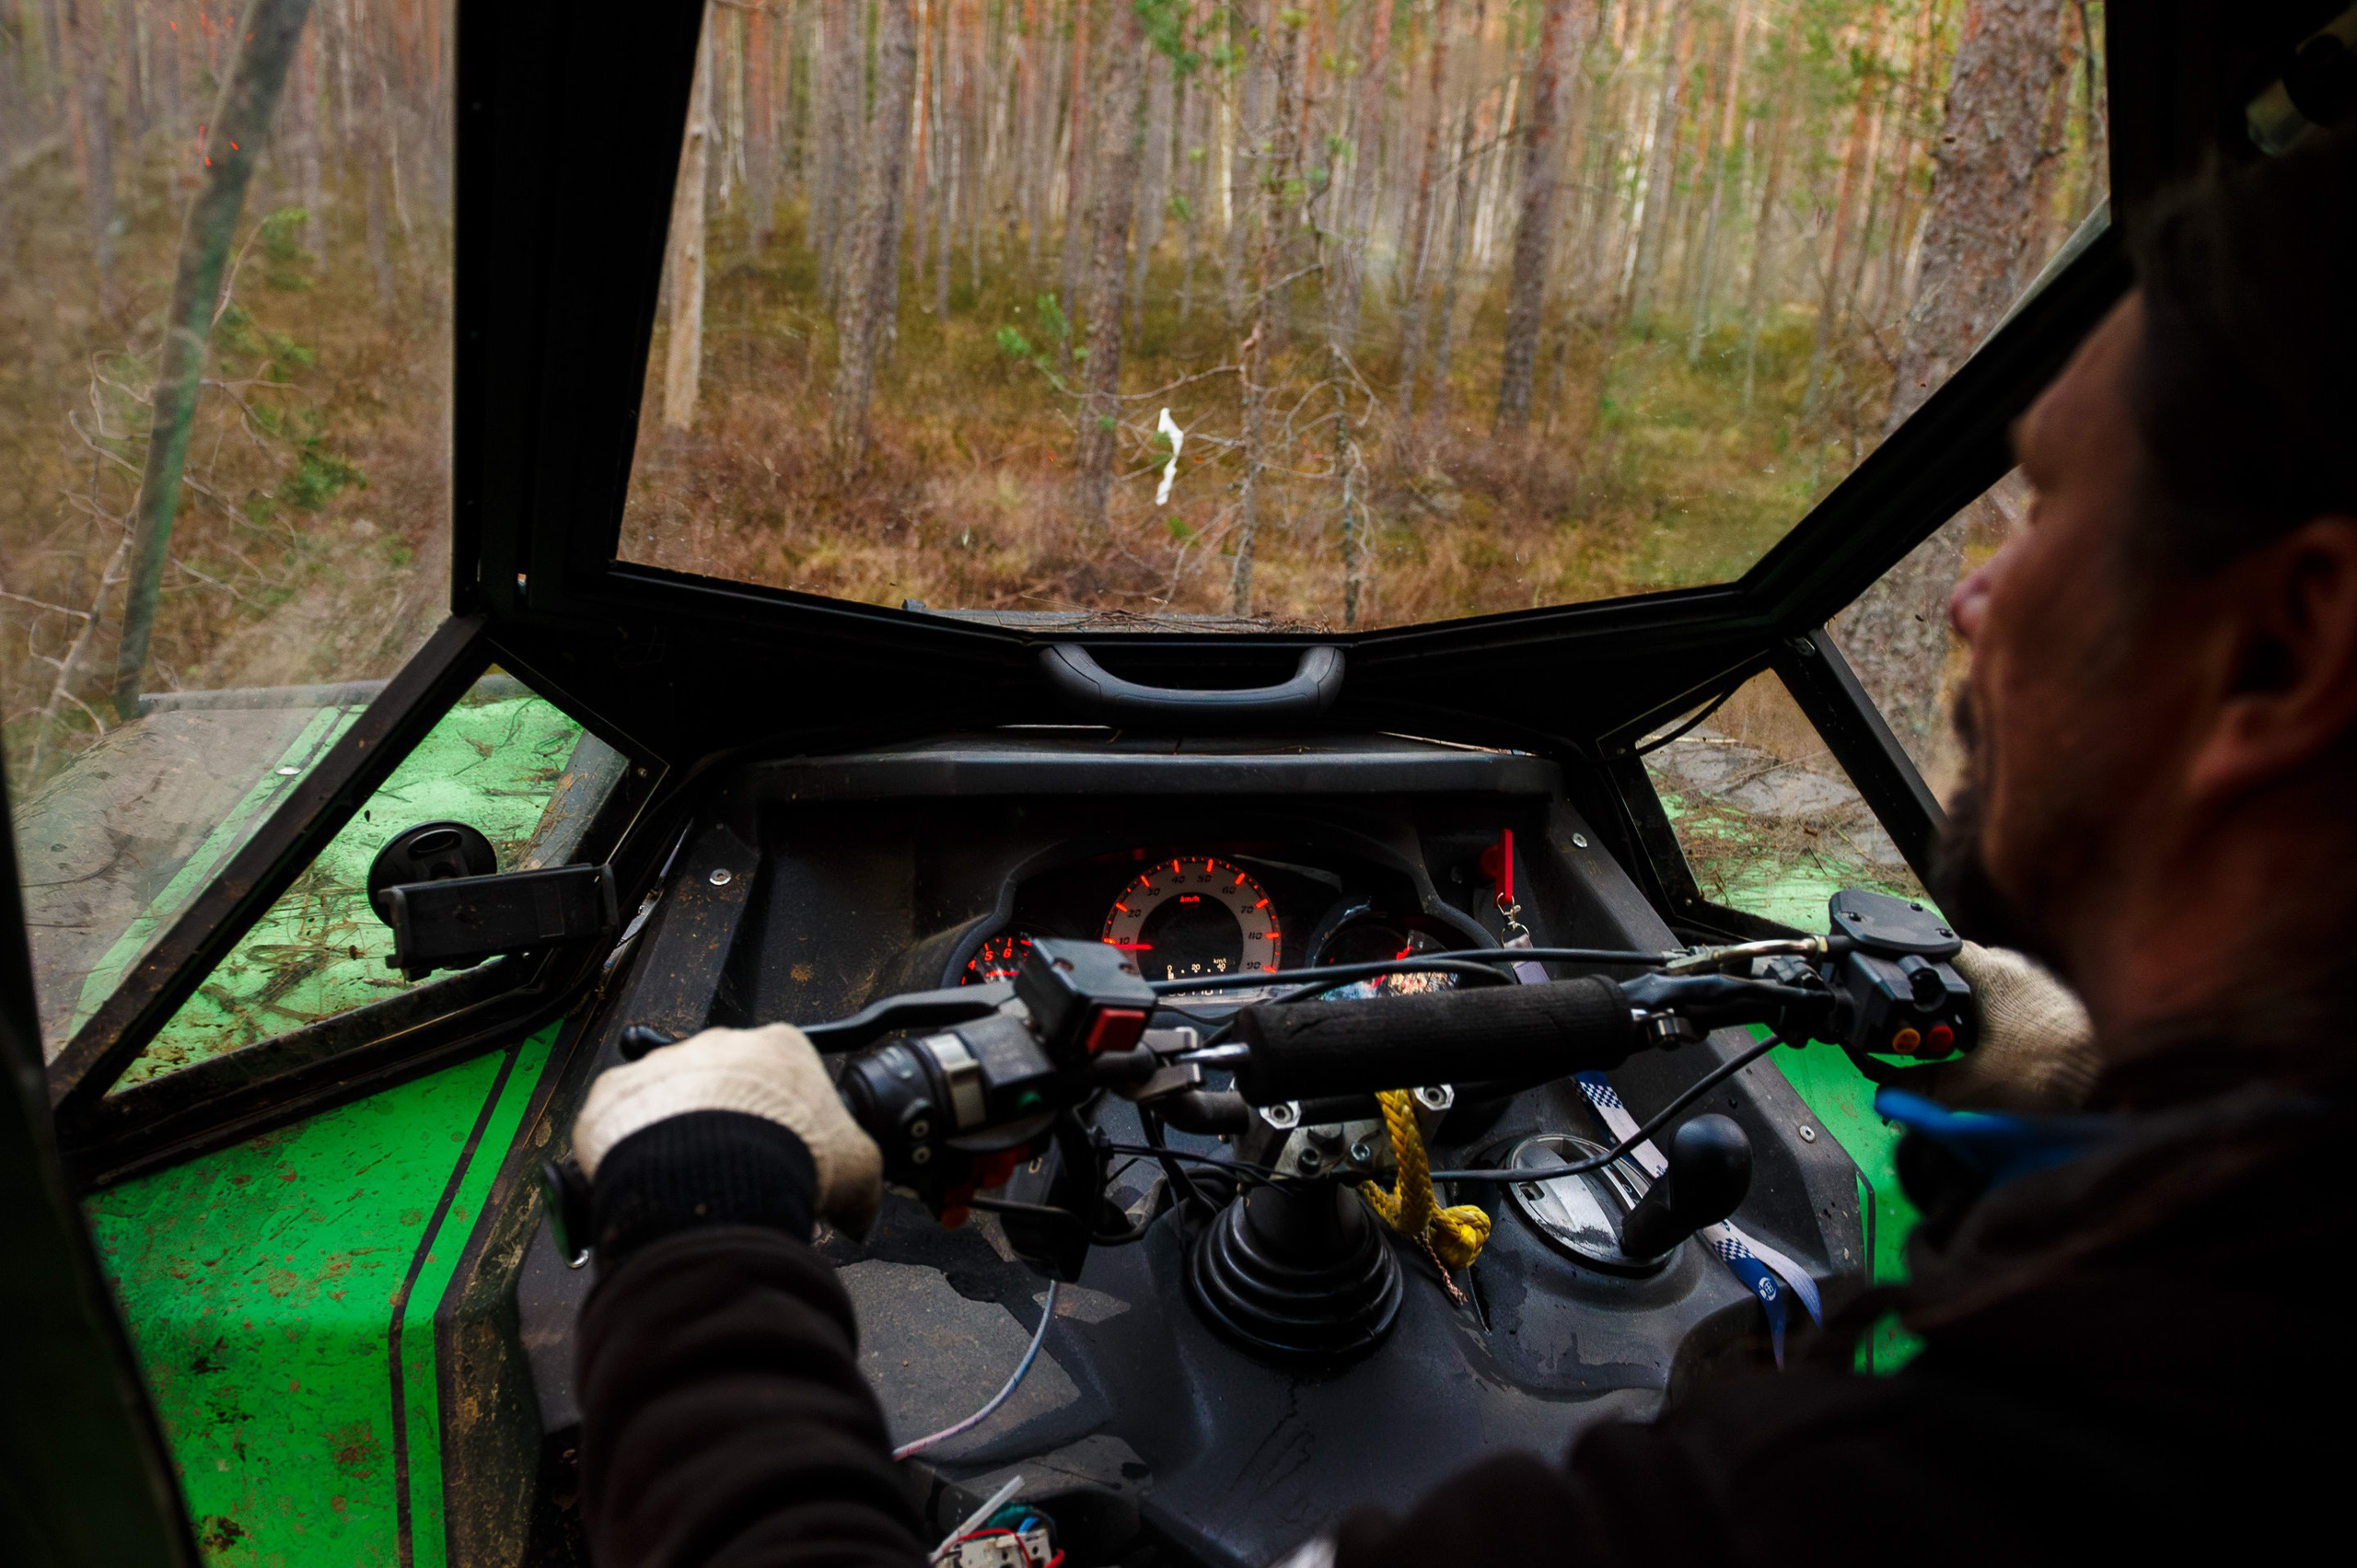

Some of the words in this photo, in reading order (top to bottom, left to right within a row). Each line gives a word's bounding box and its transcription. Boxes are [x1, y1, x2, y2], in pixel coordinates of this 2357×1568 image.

[1171, 876, 1185, 884] 40
[1128, 909, 1142, 918] 20
[1240, 905, 1254, 914] 70
[984, 951, 993, 961] 5
[1003, 948, 1012, 958] 6
[968, 959, 976, 970] 4
[1246, 960, 1261, 970] 90
